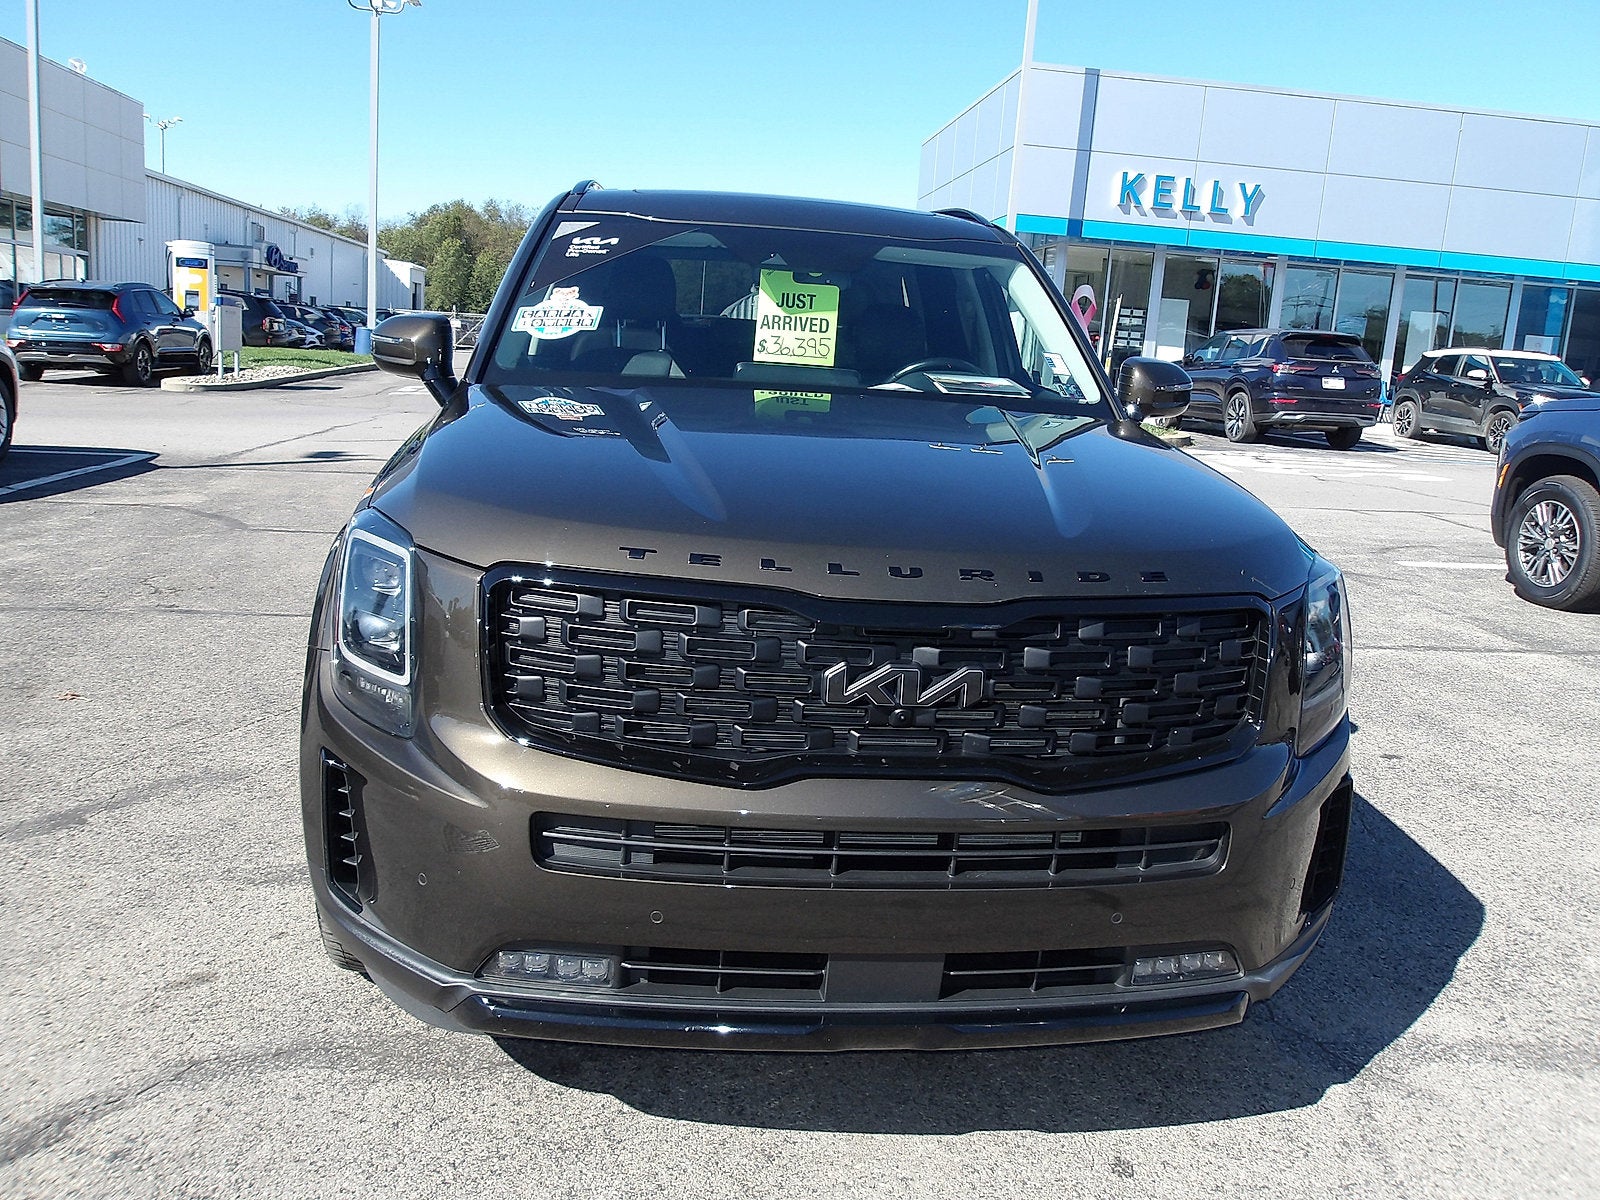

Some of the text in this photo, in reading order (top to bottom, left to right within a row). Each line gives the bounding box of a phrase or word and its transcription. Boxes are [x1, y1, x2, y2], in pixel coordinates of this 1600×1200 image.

[1119, 171, 1262, 217] KELLY
[776, 292, 817, 310] JUST
[760, 314, 830, 334] ARRIVED
[619, 546, 1169, 583] TELLURIDE
[823, 661, 985, 708] KIA
